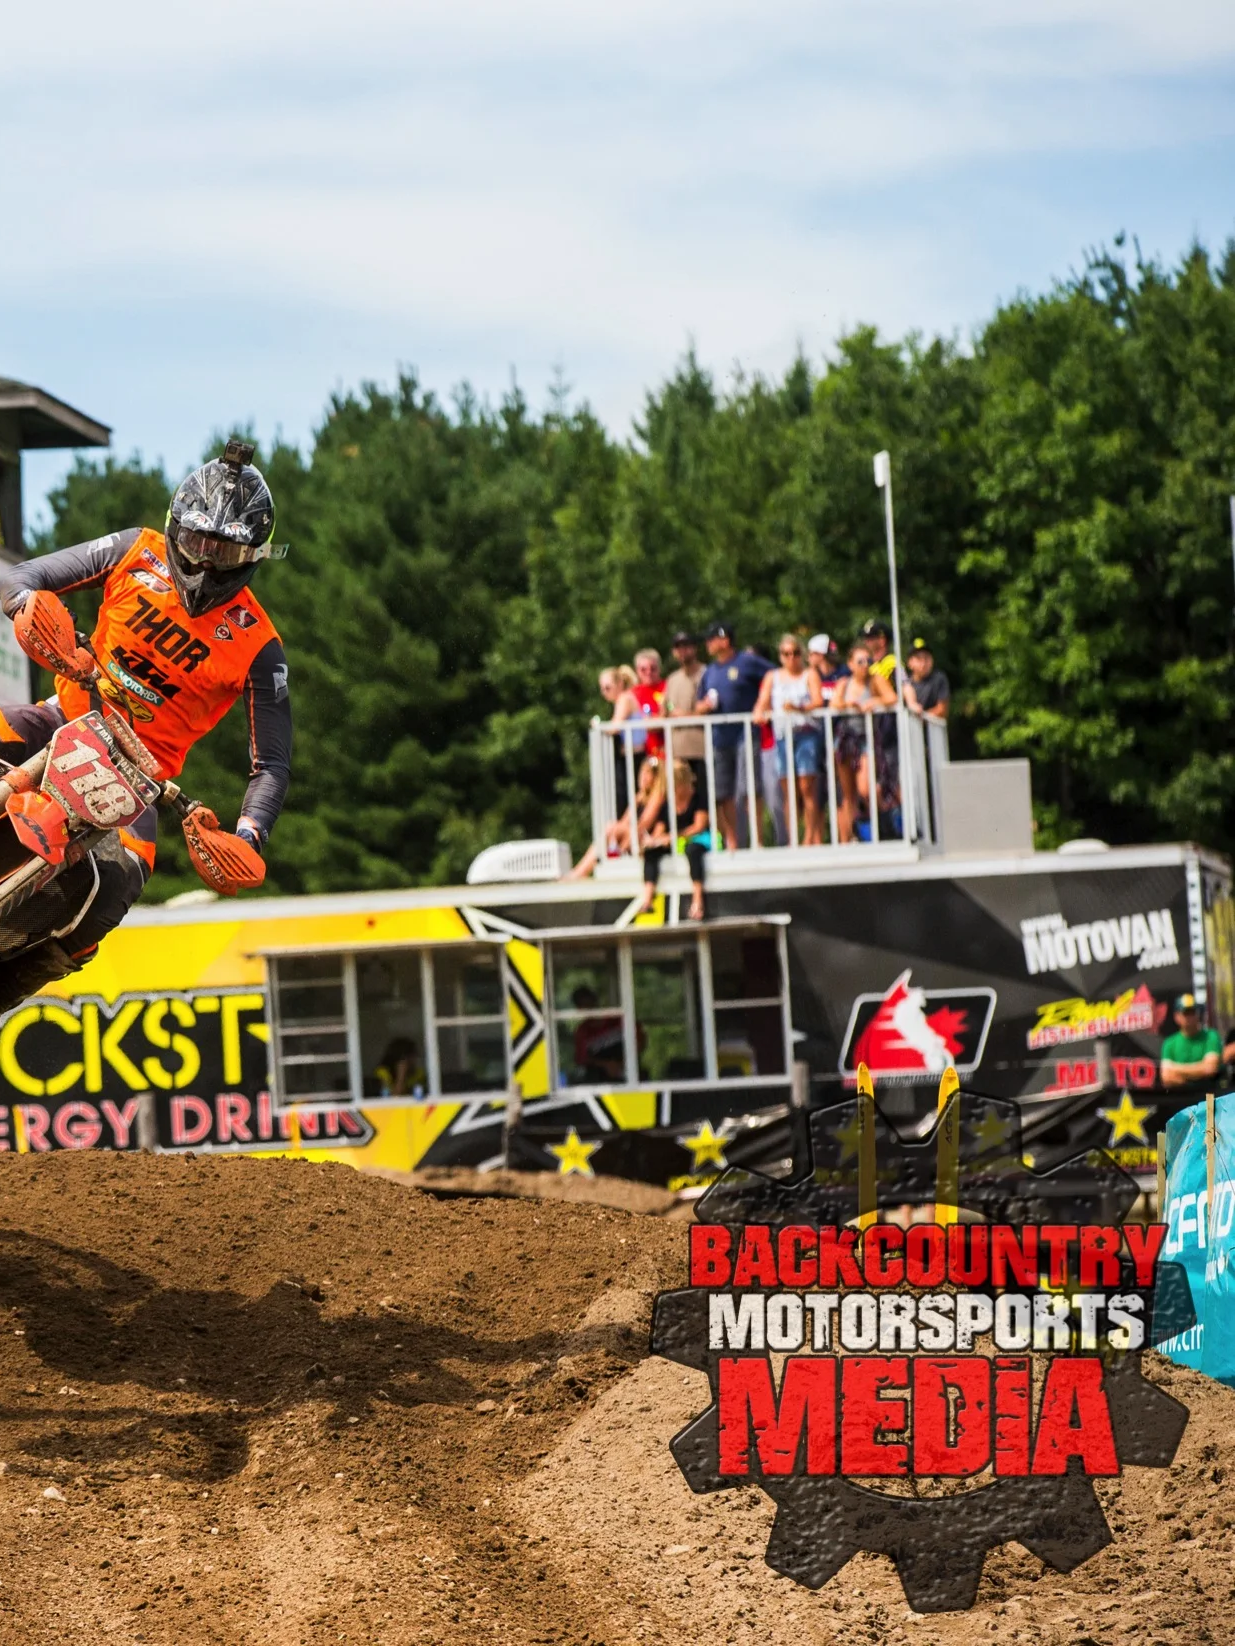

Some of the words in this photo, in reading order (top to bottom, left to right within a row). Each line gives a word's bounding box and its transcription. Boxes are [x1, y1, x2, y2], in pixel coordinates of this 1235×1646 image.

[124, 594, 211, 674] THOR
[111, 645, 182, 699] KTM
[119, 670, 160, 704] MOTOREX
[51, 738, 137, 825] 118
[1022, 908, 1177, 976] MOTOVAN
